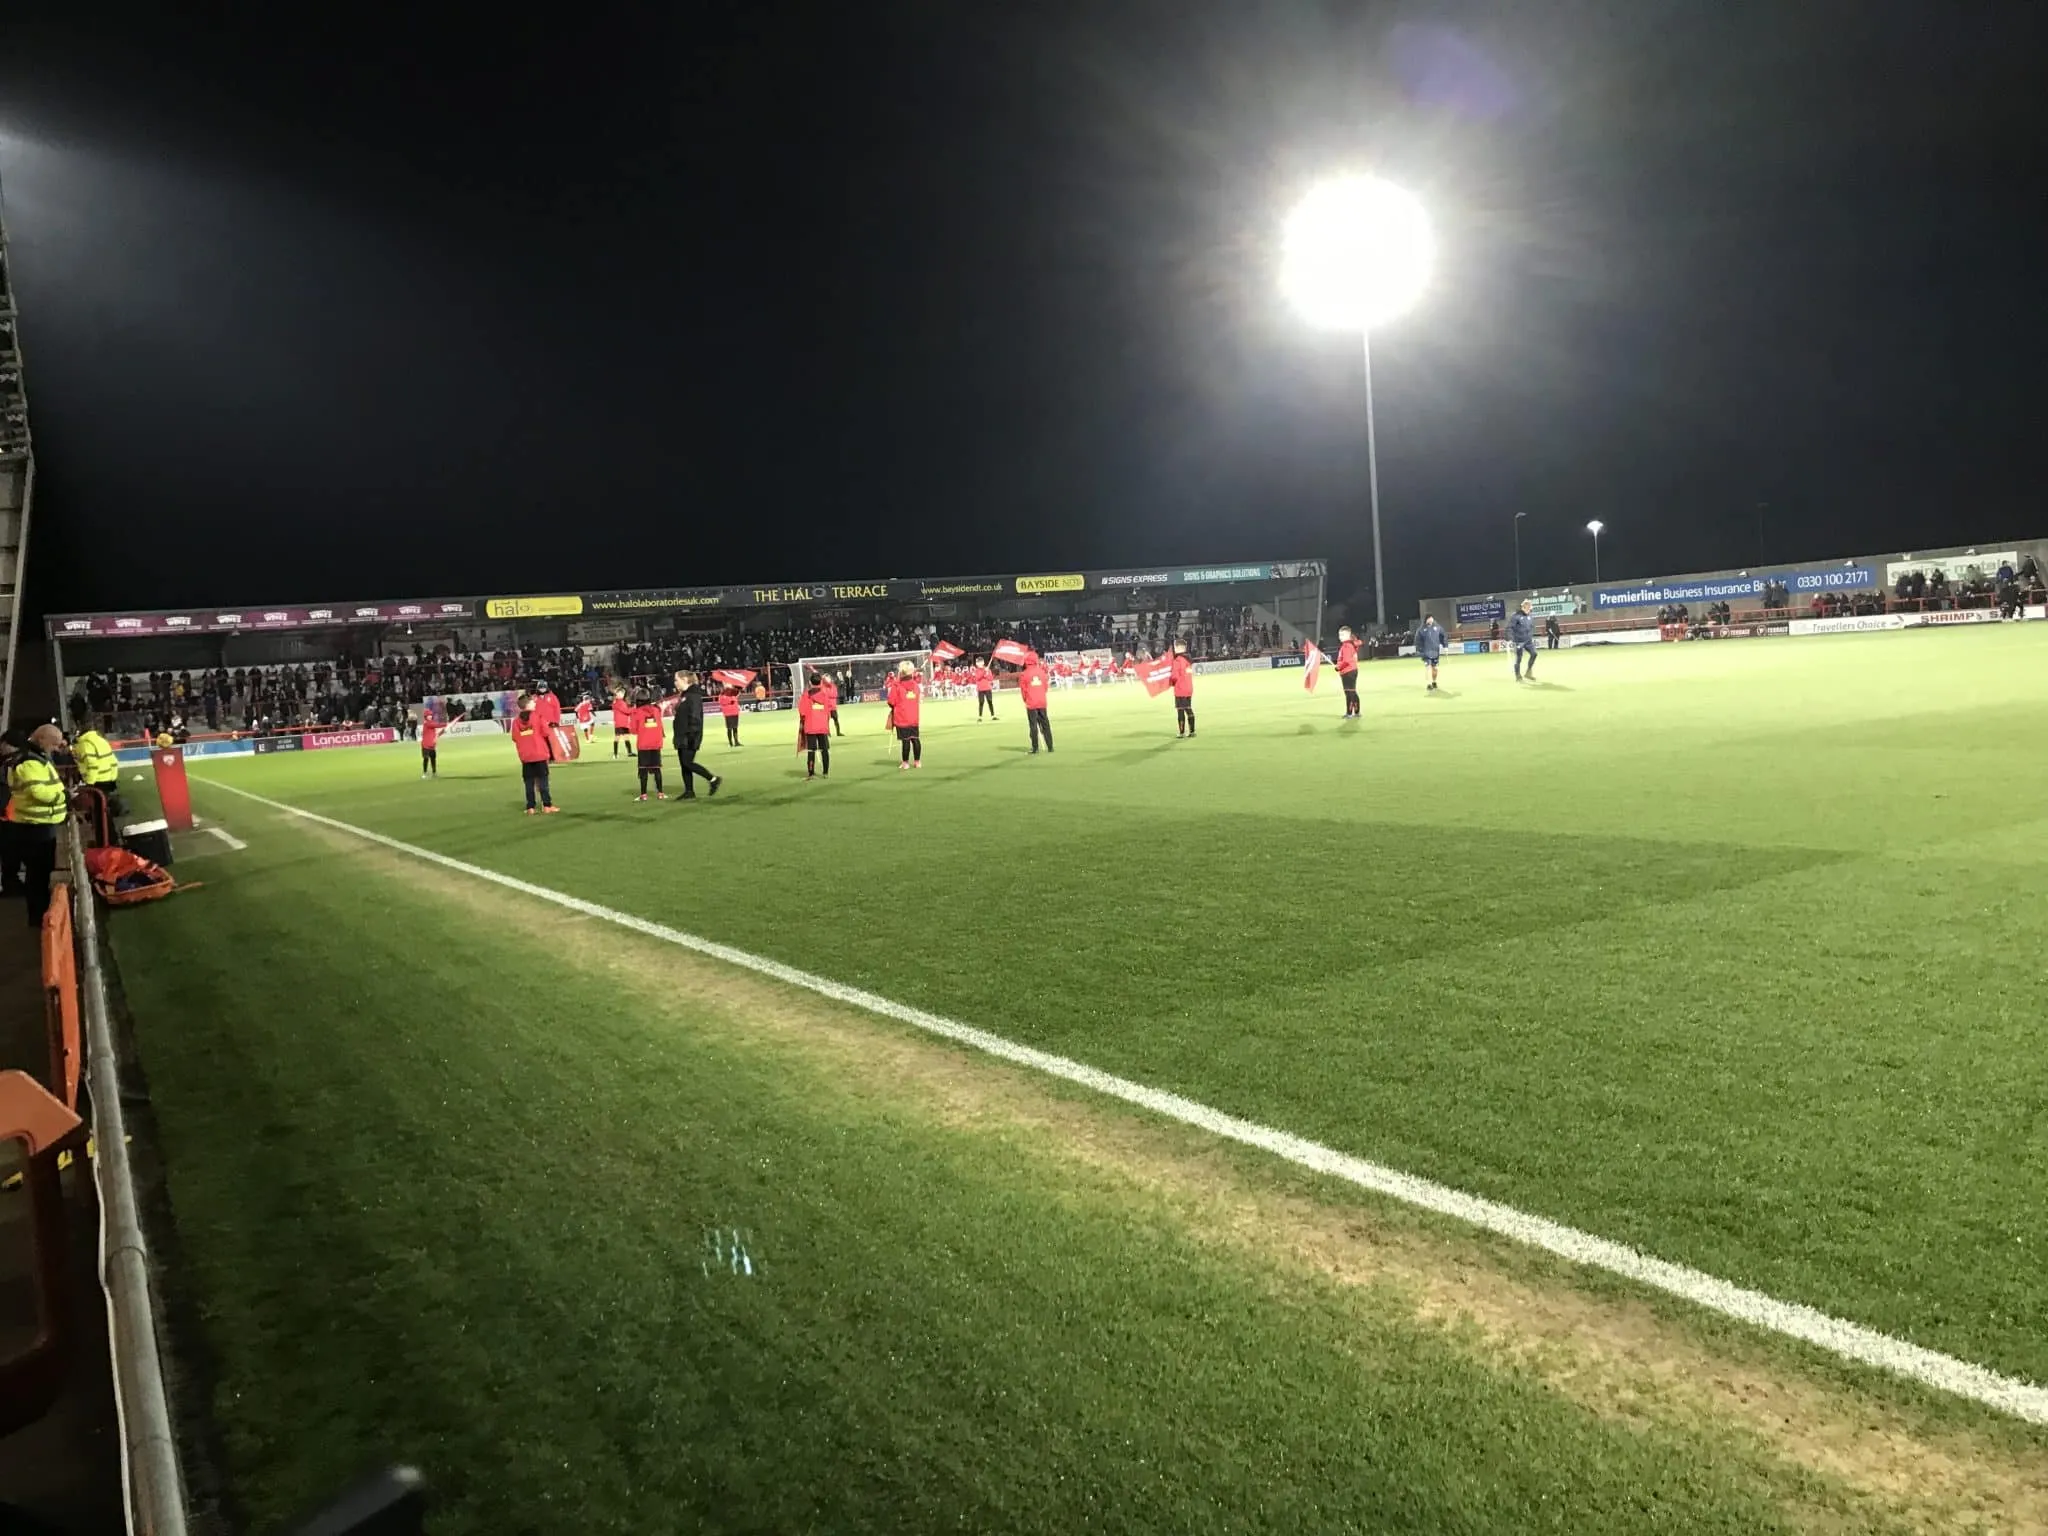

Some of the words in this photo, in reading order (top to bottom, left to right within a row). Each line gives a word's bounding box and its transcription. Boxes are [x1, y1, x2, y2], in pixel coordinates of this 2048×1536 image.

[1021, 580, 1060, 589] BAYSIDE
[1108, 576, 1132, 584] SIGNS
[1133, 574, 1168, 583] EXPRESS
[1797, 576, 1822, 588] 0330
[1825, 573, 1843, 586] 100
[1845, 571, 1868, 584] 2171
[753, 590, 780, 602] THE
[832, 586, 888, 598] TERRACE
[1600, 588, 1661, 605] Premierline
[1664, 587, 1702, 600] Business
[1705, 581, 1750, 596] Insurance
[1813, 620, 1855, 632] Travellers
[1856, 619, 1887, 630] Choice
[450, 725, 471, 734] Lord
[312, 731, 385, 746] Lancastrian
